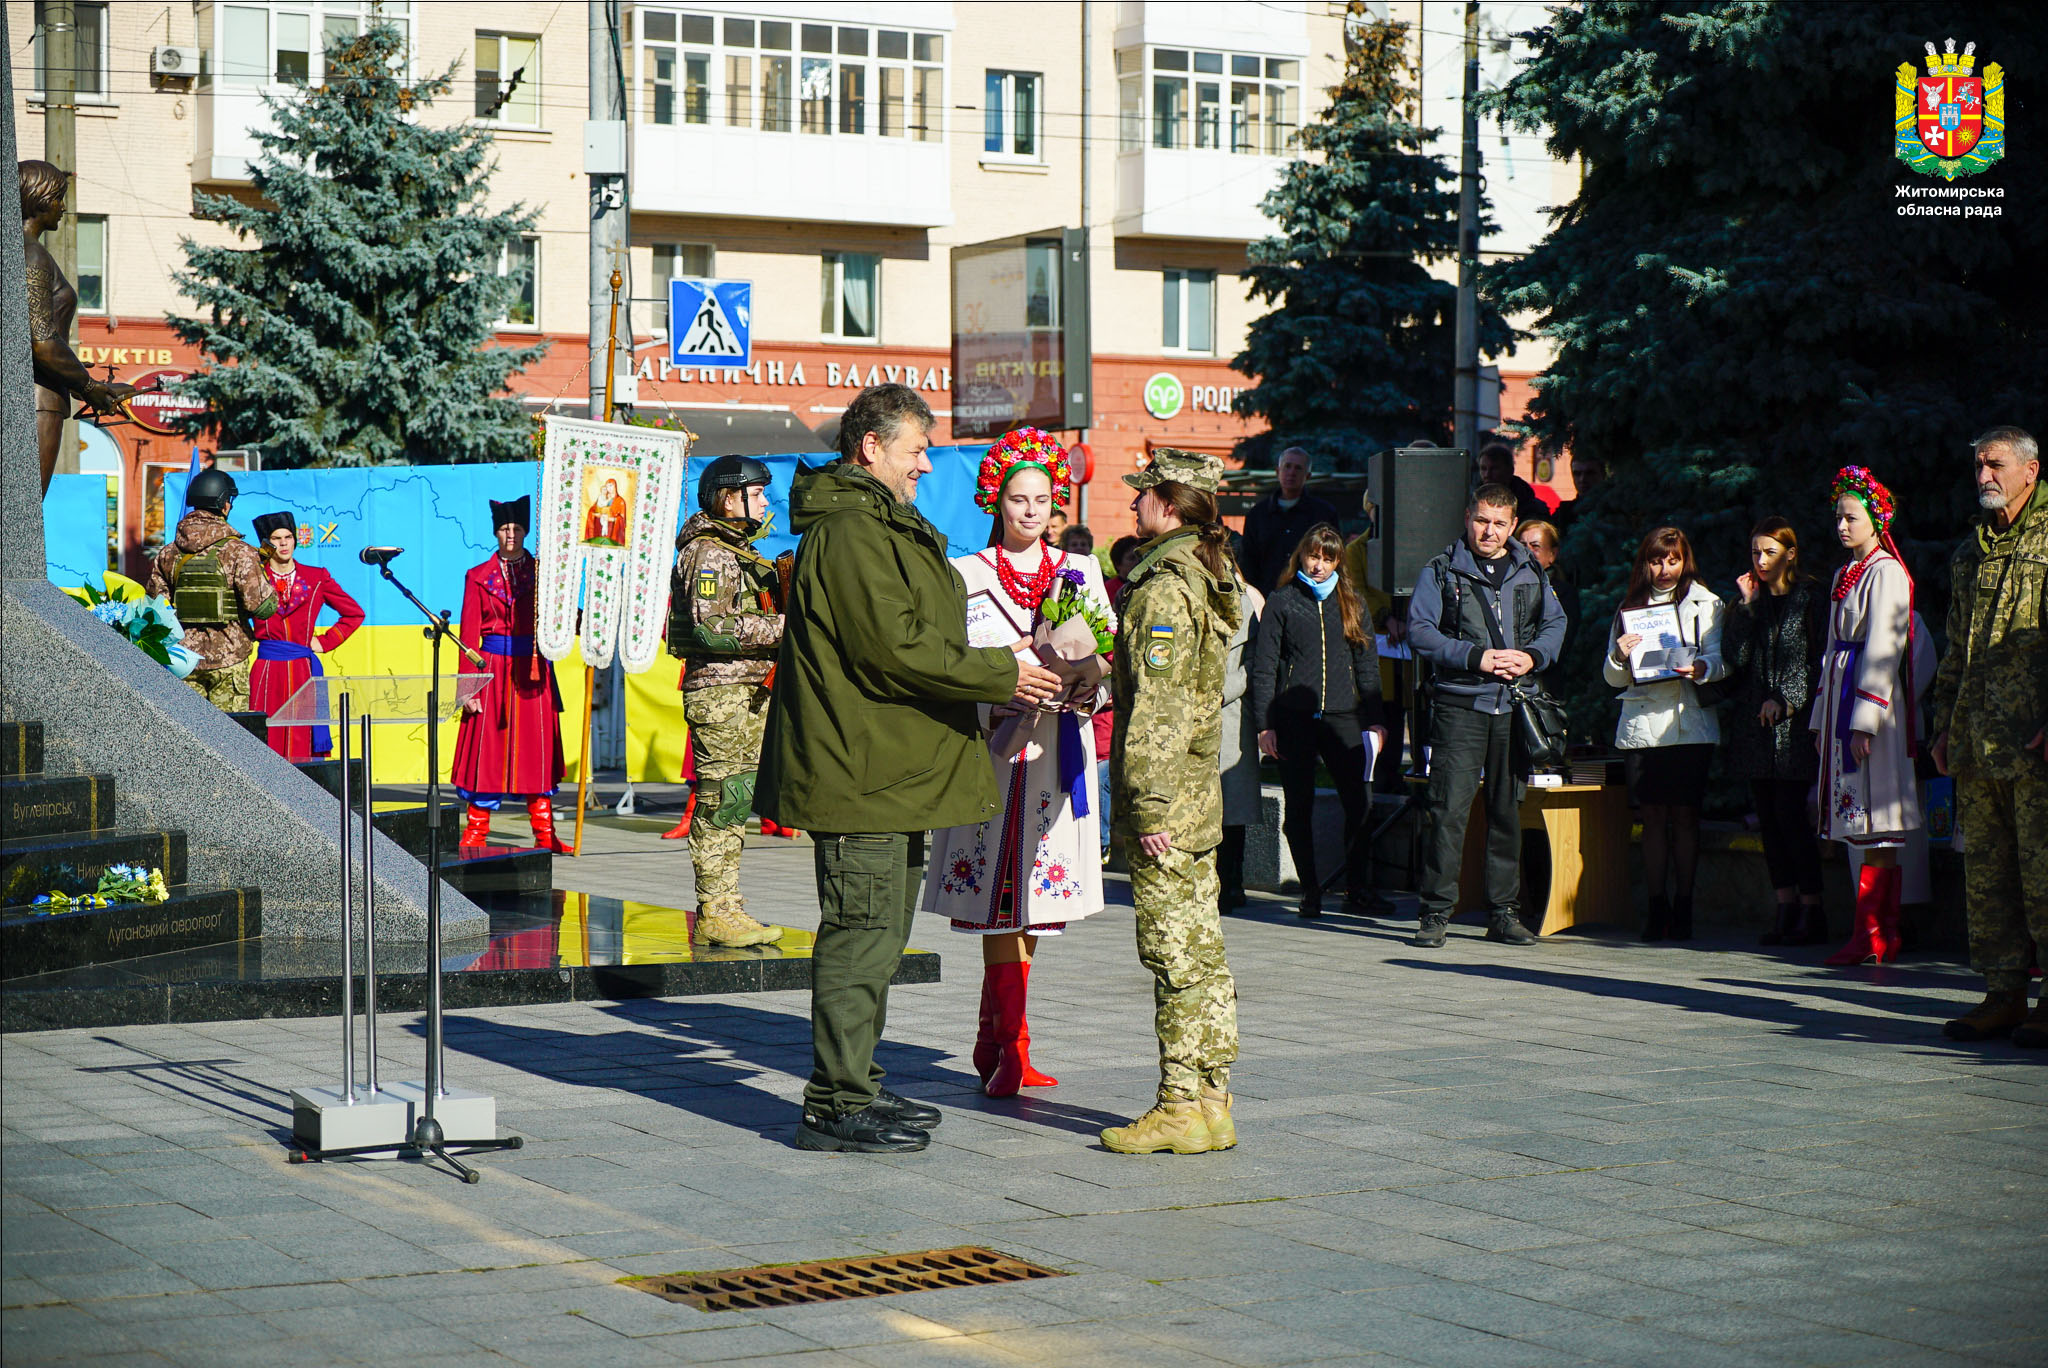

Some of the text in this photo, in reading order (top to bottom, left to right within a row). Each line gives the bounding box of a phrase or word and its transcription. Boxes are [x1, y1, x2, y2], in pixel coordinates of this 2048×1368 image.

[1633, 618, 1670, 630] ПОДЯКА
[13, 801, 73, 821] Вуглегірськ
[107, 913, 222, 946] Луганський аеропорт
